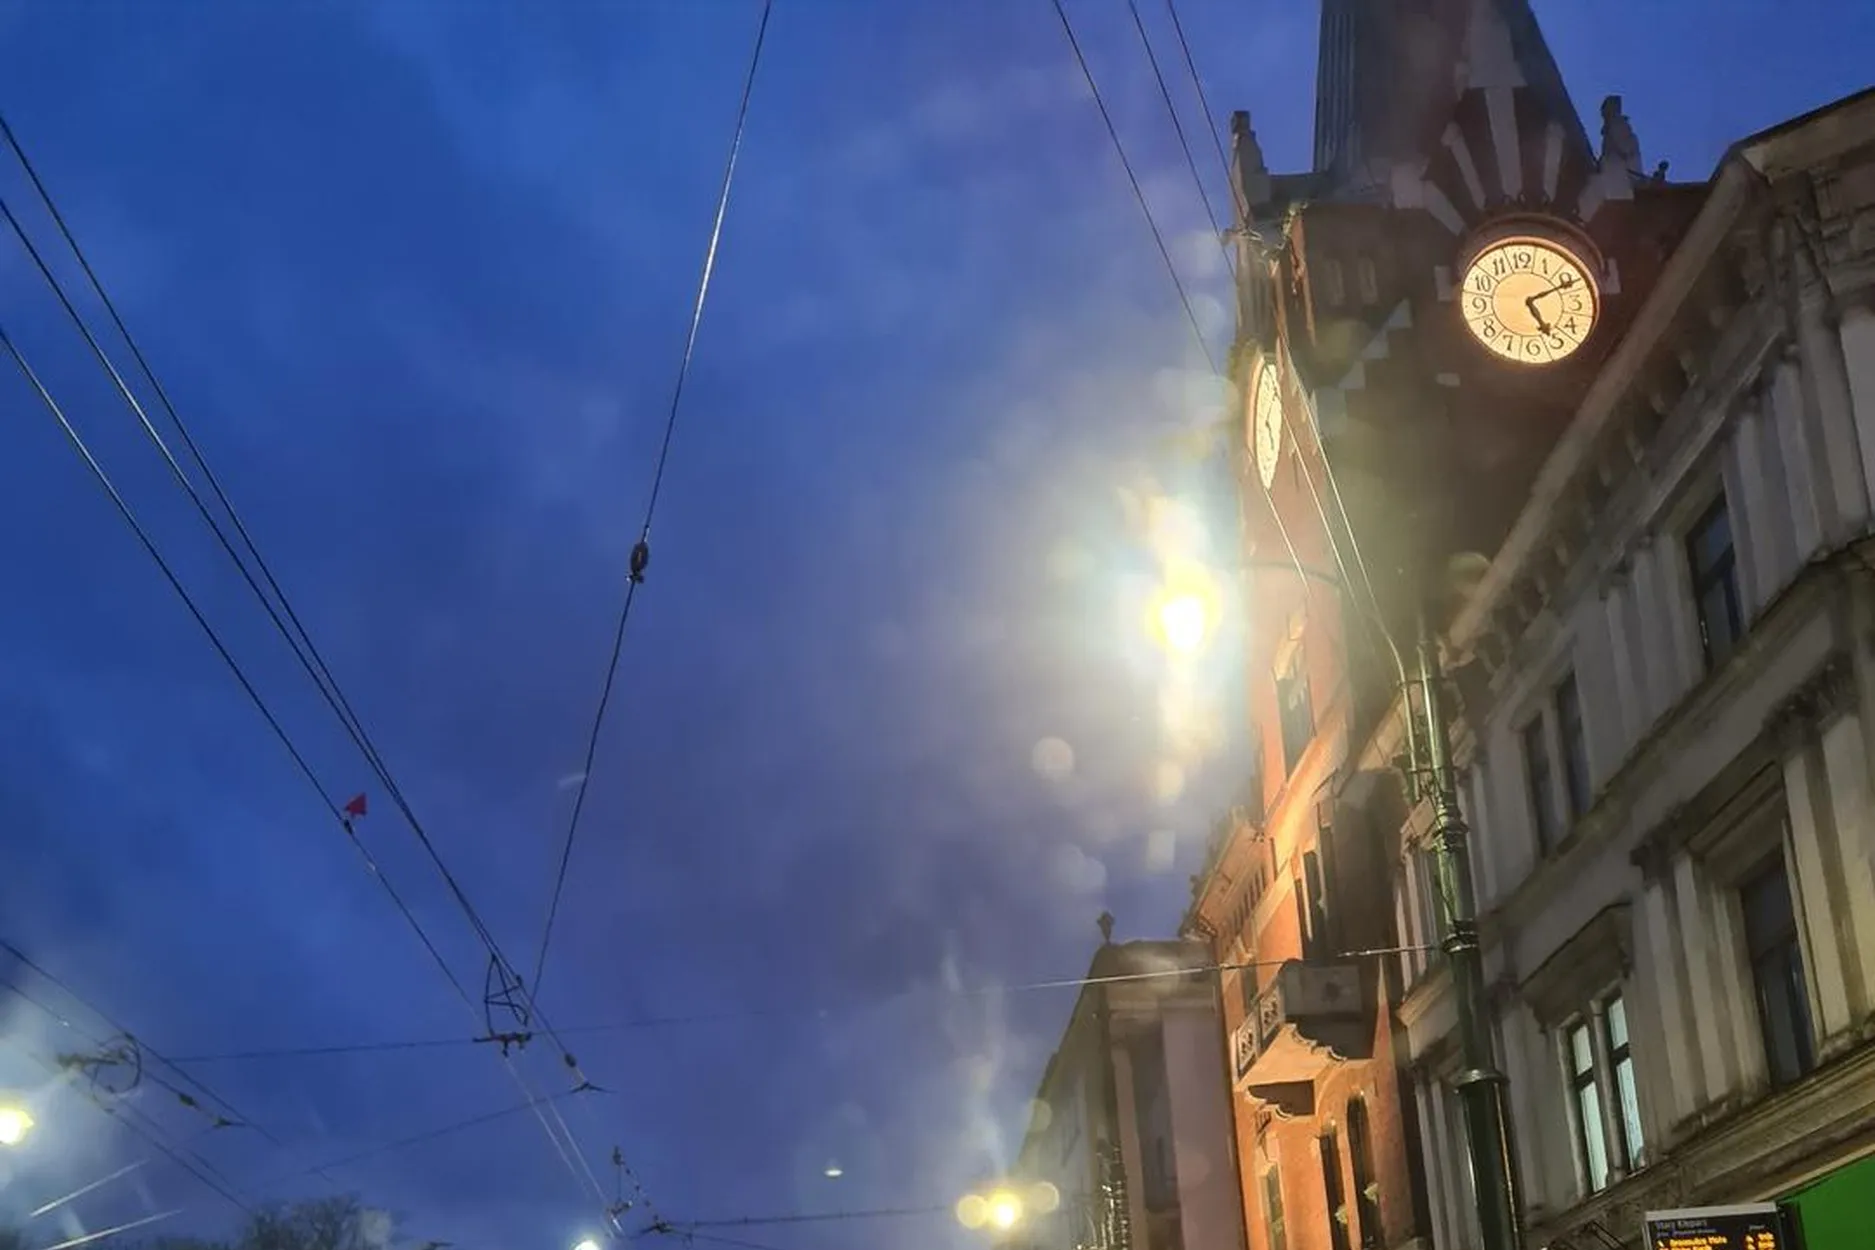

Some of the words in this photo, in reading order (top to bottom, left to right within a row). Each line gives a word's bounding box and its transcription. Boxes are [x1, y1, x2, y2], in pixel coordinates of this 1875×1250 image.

[1492, 257, 1506, 276] 11
[1512, 251, 1531, 269] 12
[1475, 274, 1492, 292] 10
[1472, 296, 1487, 314] 9
[1568, 293, 1583, 312] 3
[1483, 318, 1496, 338] 8
[1564, 316, 1577, 335] 4
[1503, 335, 1514, 351] 7
[1525, 338, 1541, 356] 6
[1548, 332, 1564, 350] 5
